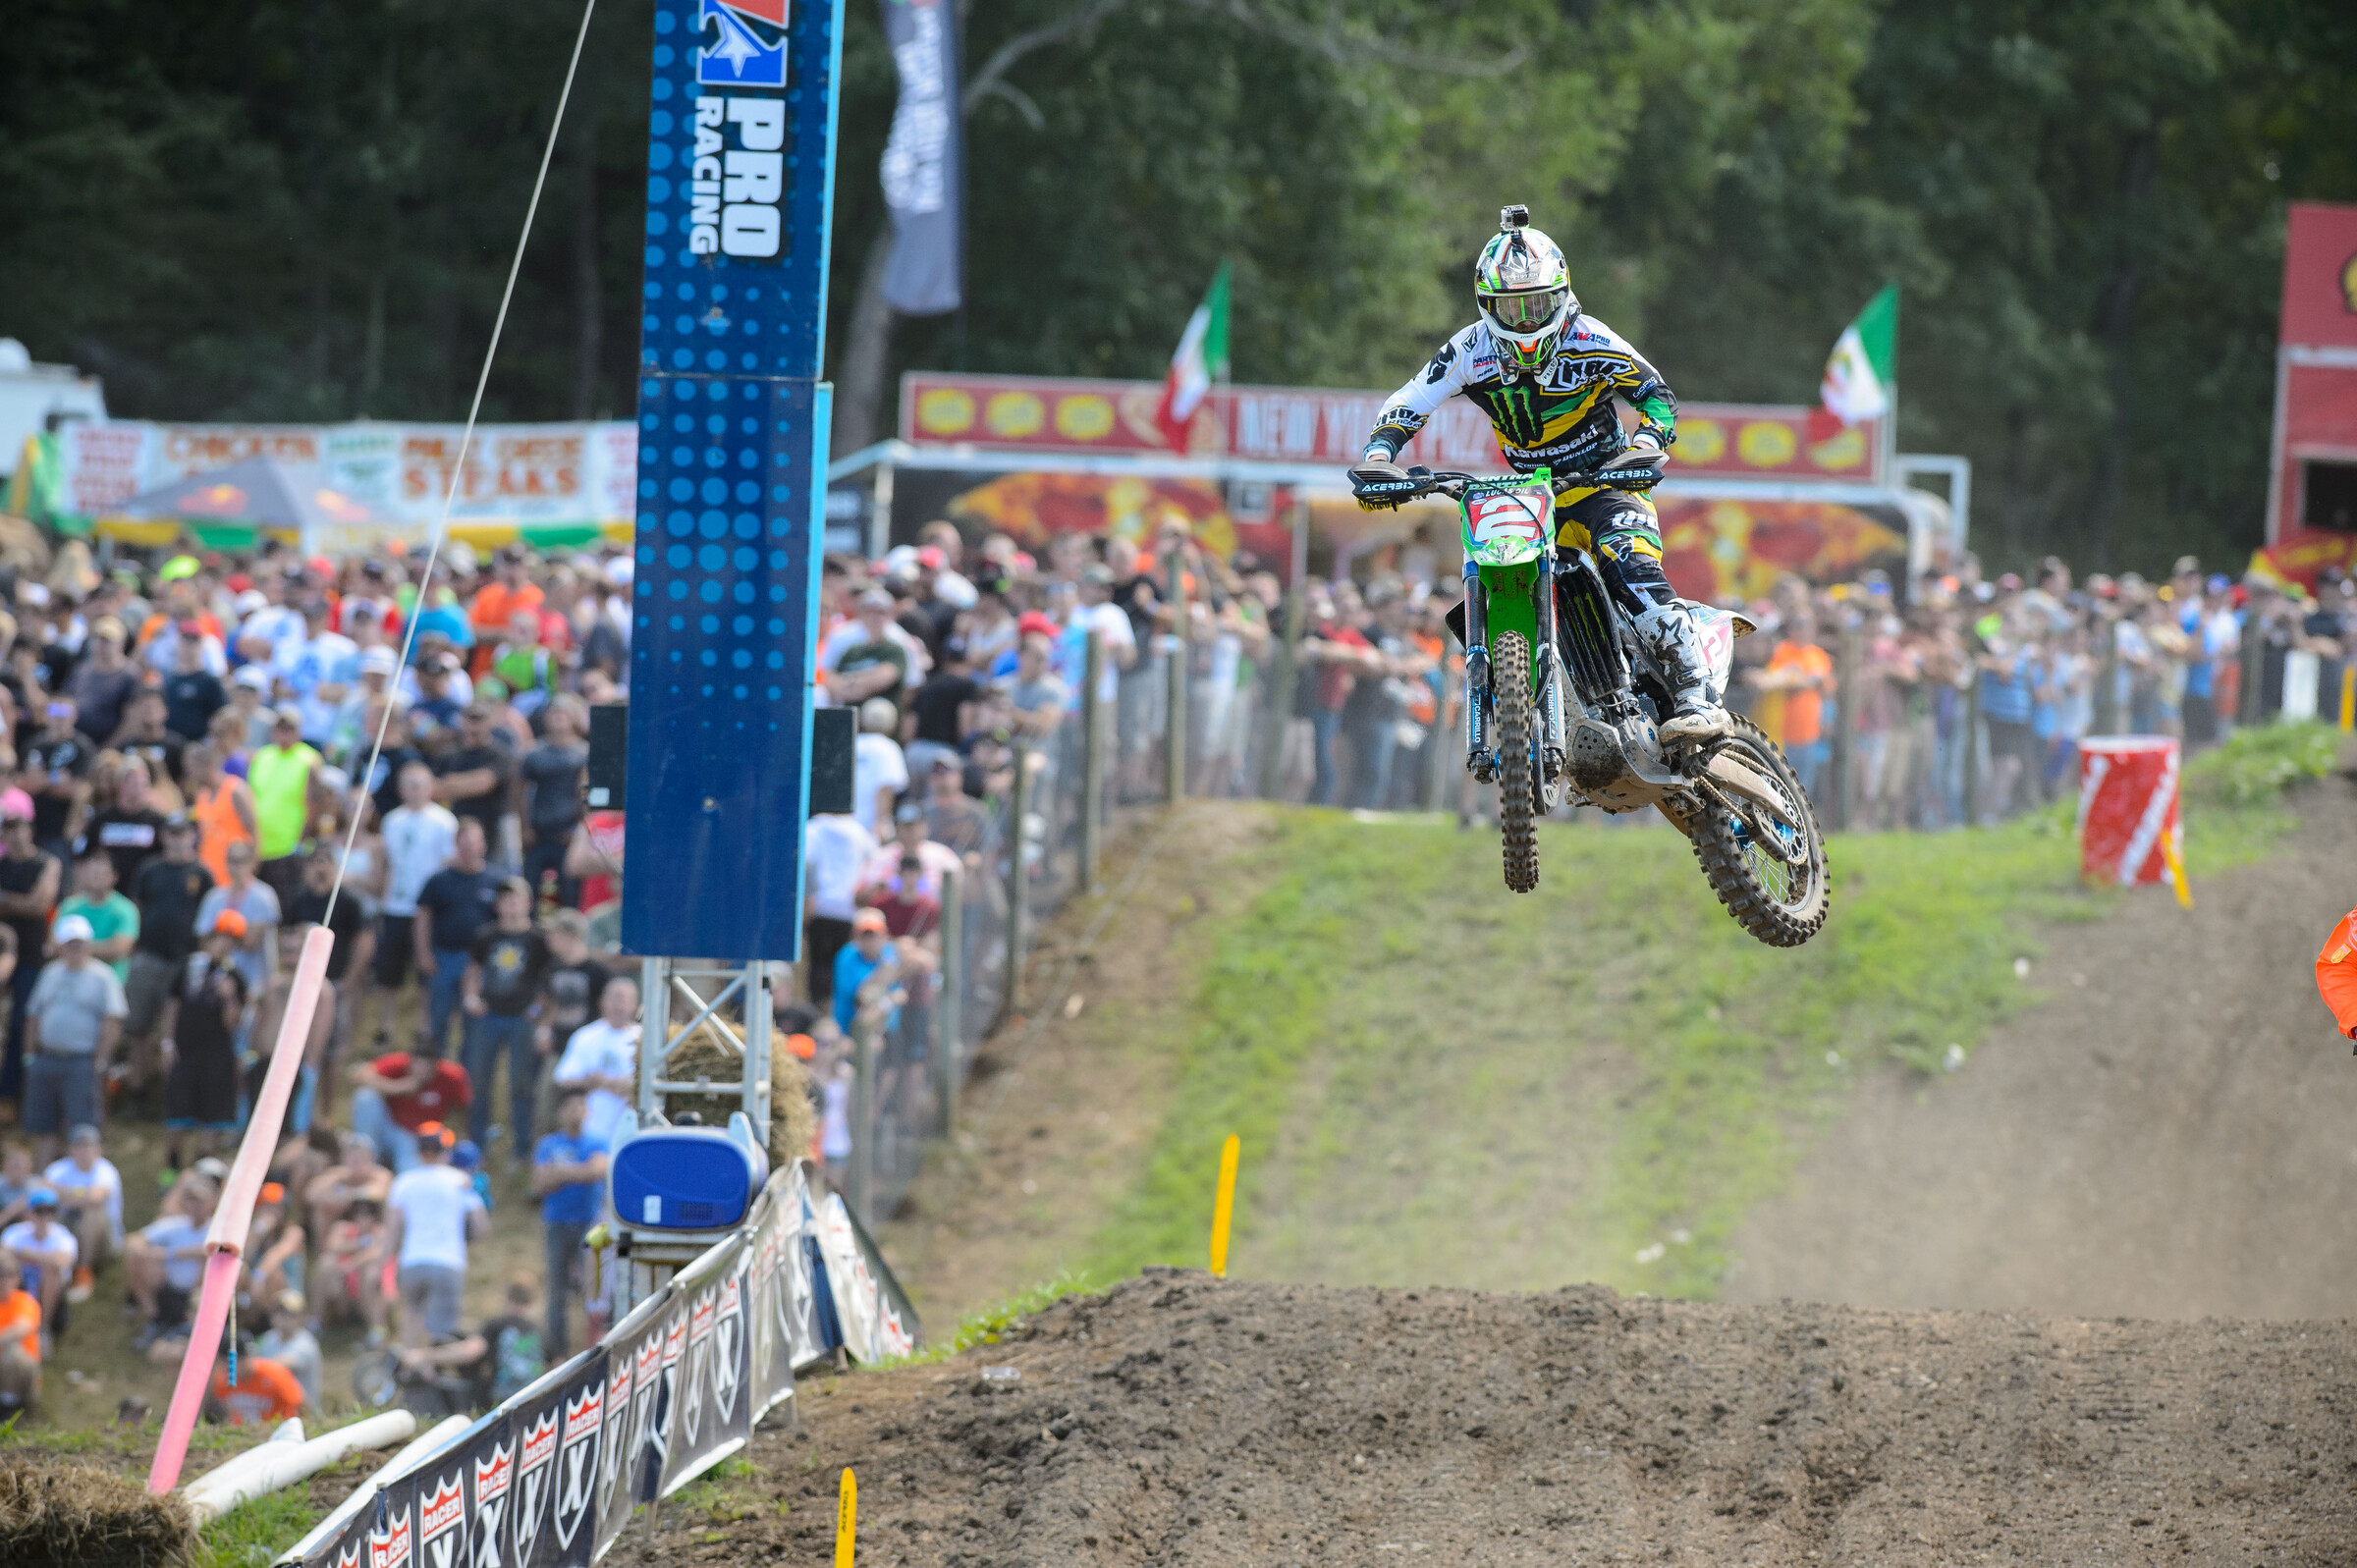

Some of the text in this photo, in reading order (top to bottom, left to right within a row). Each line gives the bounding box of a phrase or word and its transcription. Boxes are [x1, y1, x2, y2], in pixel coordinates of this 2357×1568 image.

[689, 96, 724, 255] RACING
[722, 98, 786, 257] PRO
[1567, 332, 1596, 342] AMA
[1596, 334, 1611, 345] PRO
[1632, 376, 1656, 399] GoPro
[1503, 424, 1599, 459] Kawasaki
[1561, 442, 1598, 463] DUNLOP
[1362, 481, 1415, 492] ACERBIS
[1599, 468, 1654, 480] ACERBIS
[1474, 495, 1542, 543] 2
[567, 1407, 601, 1439] RACER
[522, 1434, 554, 1466] RACER
[560, 1438, 589, 1518] X
[424, 1495, 462, 1535] RACER
[520, 1466, 544, 1546] X
